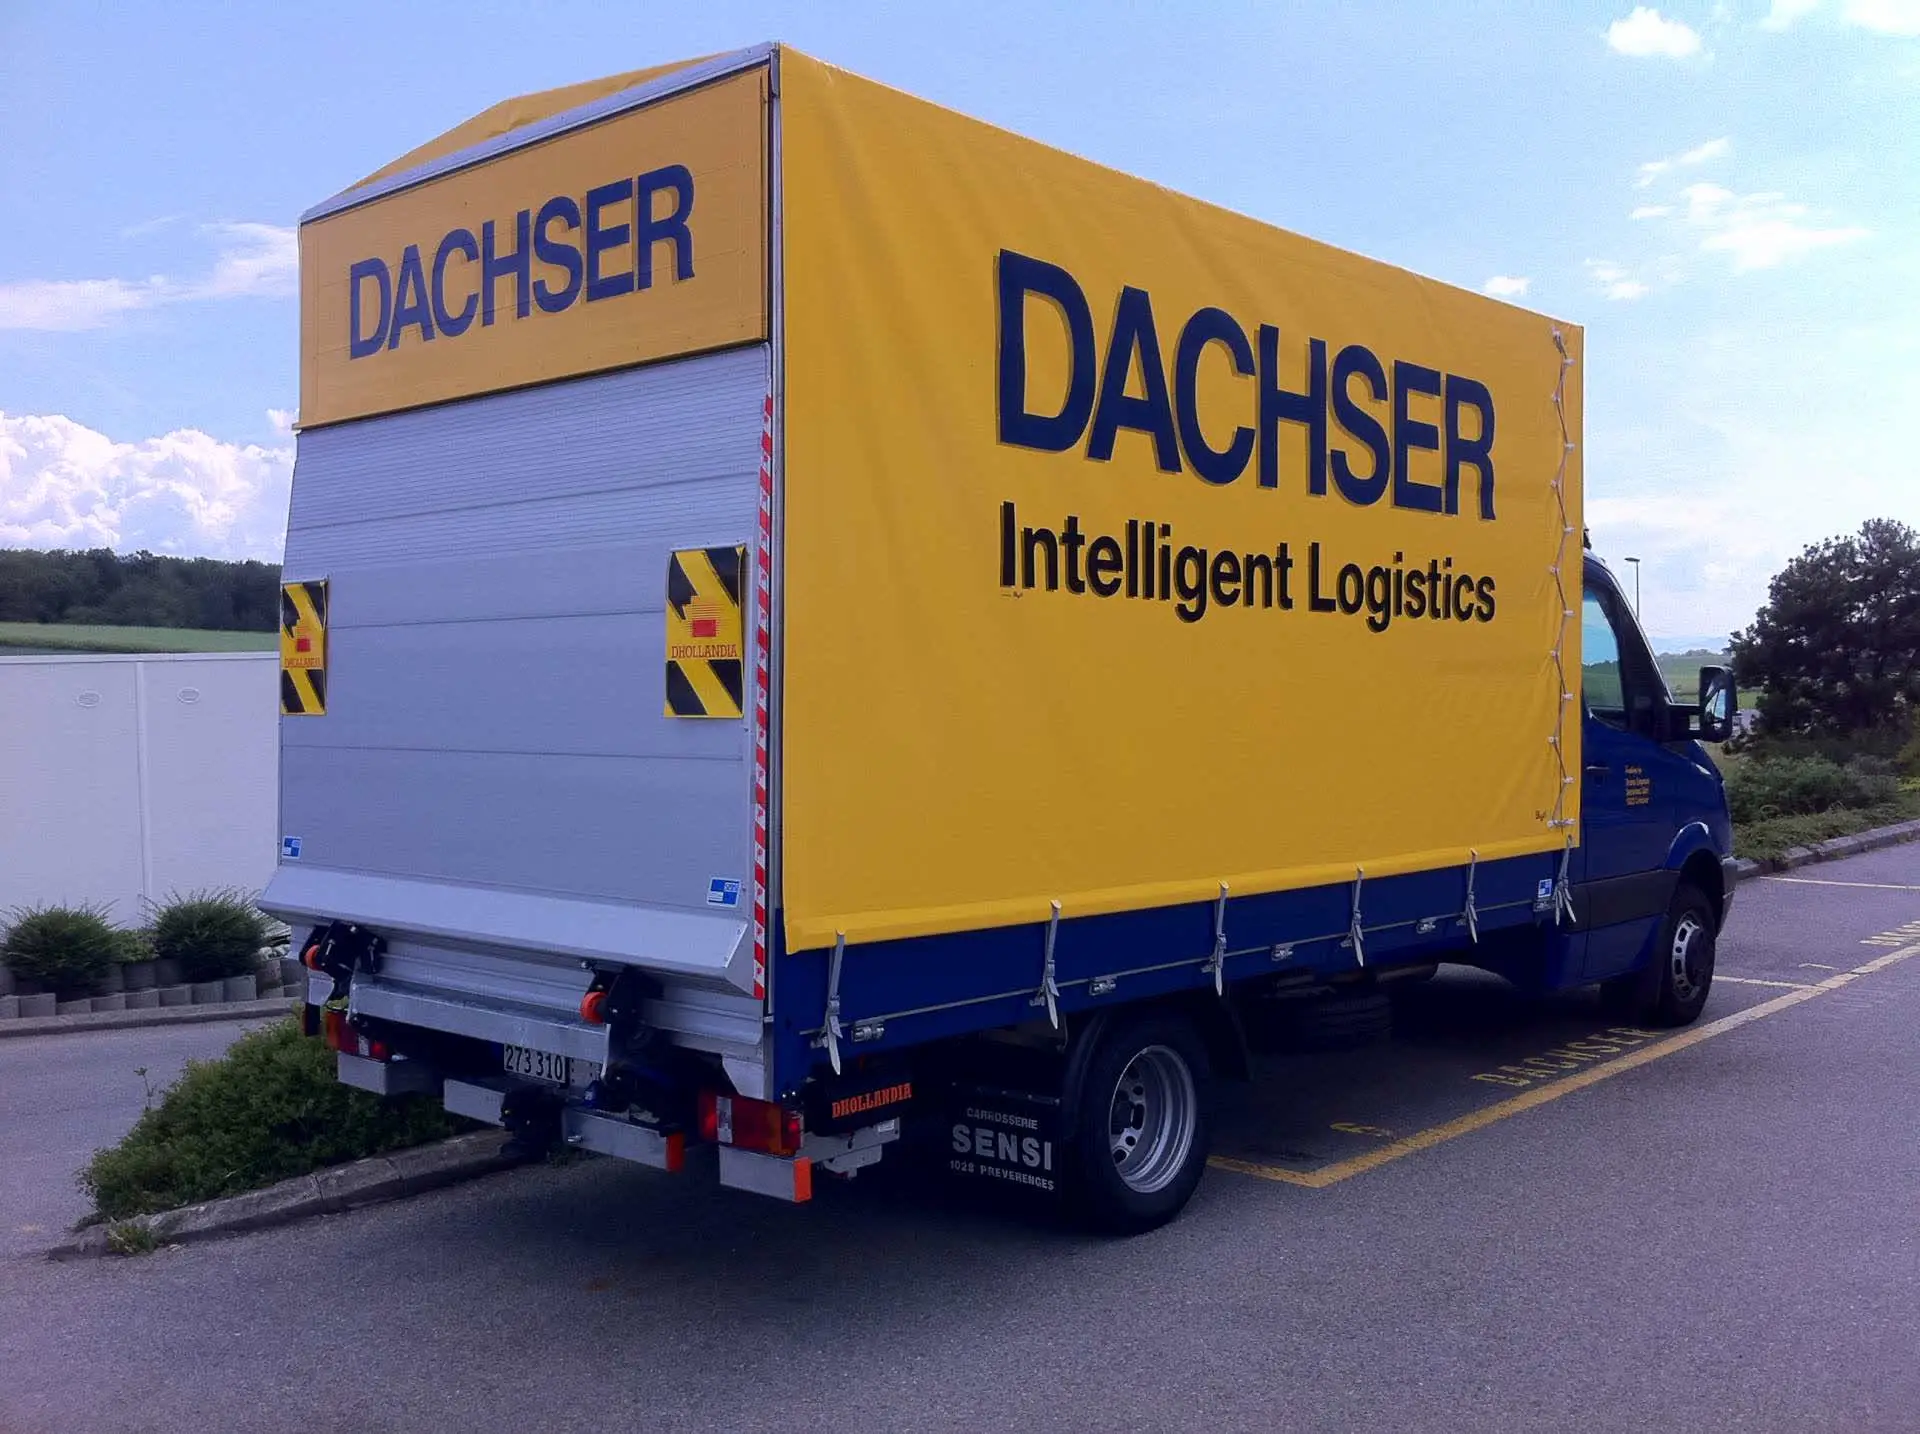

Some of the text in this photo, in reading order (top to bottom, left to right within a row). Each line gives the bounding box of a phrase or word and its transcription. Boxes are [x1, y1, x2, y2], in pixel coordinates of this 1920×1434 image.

[350, 164, 695, 361] DACHSER
[996, 248, 1496, 521] DACHSER
[1000, 500, 1496, 634] Intelligent Logistics
[671, 644, 738, 659] DHOLLANDIA
[505, 1044, 563, 1080] 273 310
[1469, 1026, 1668, 1087] DACHSER
[831, 1082, 912, 1119] DHOLLANDIA
[966, 1107, 1039, 1130] CARROSSERIE
[952, 1124, 1052, 1171] SENSI
[950, 1160, 1055, 1191] 1028 PREVERENGES
